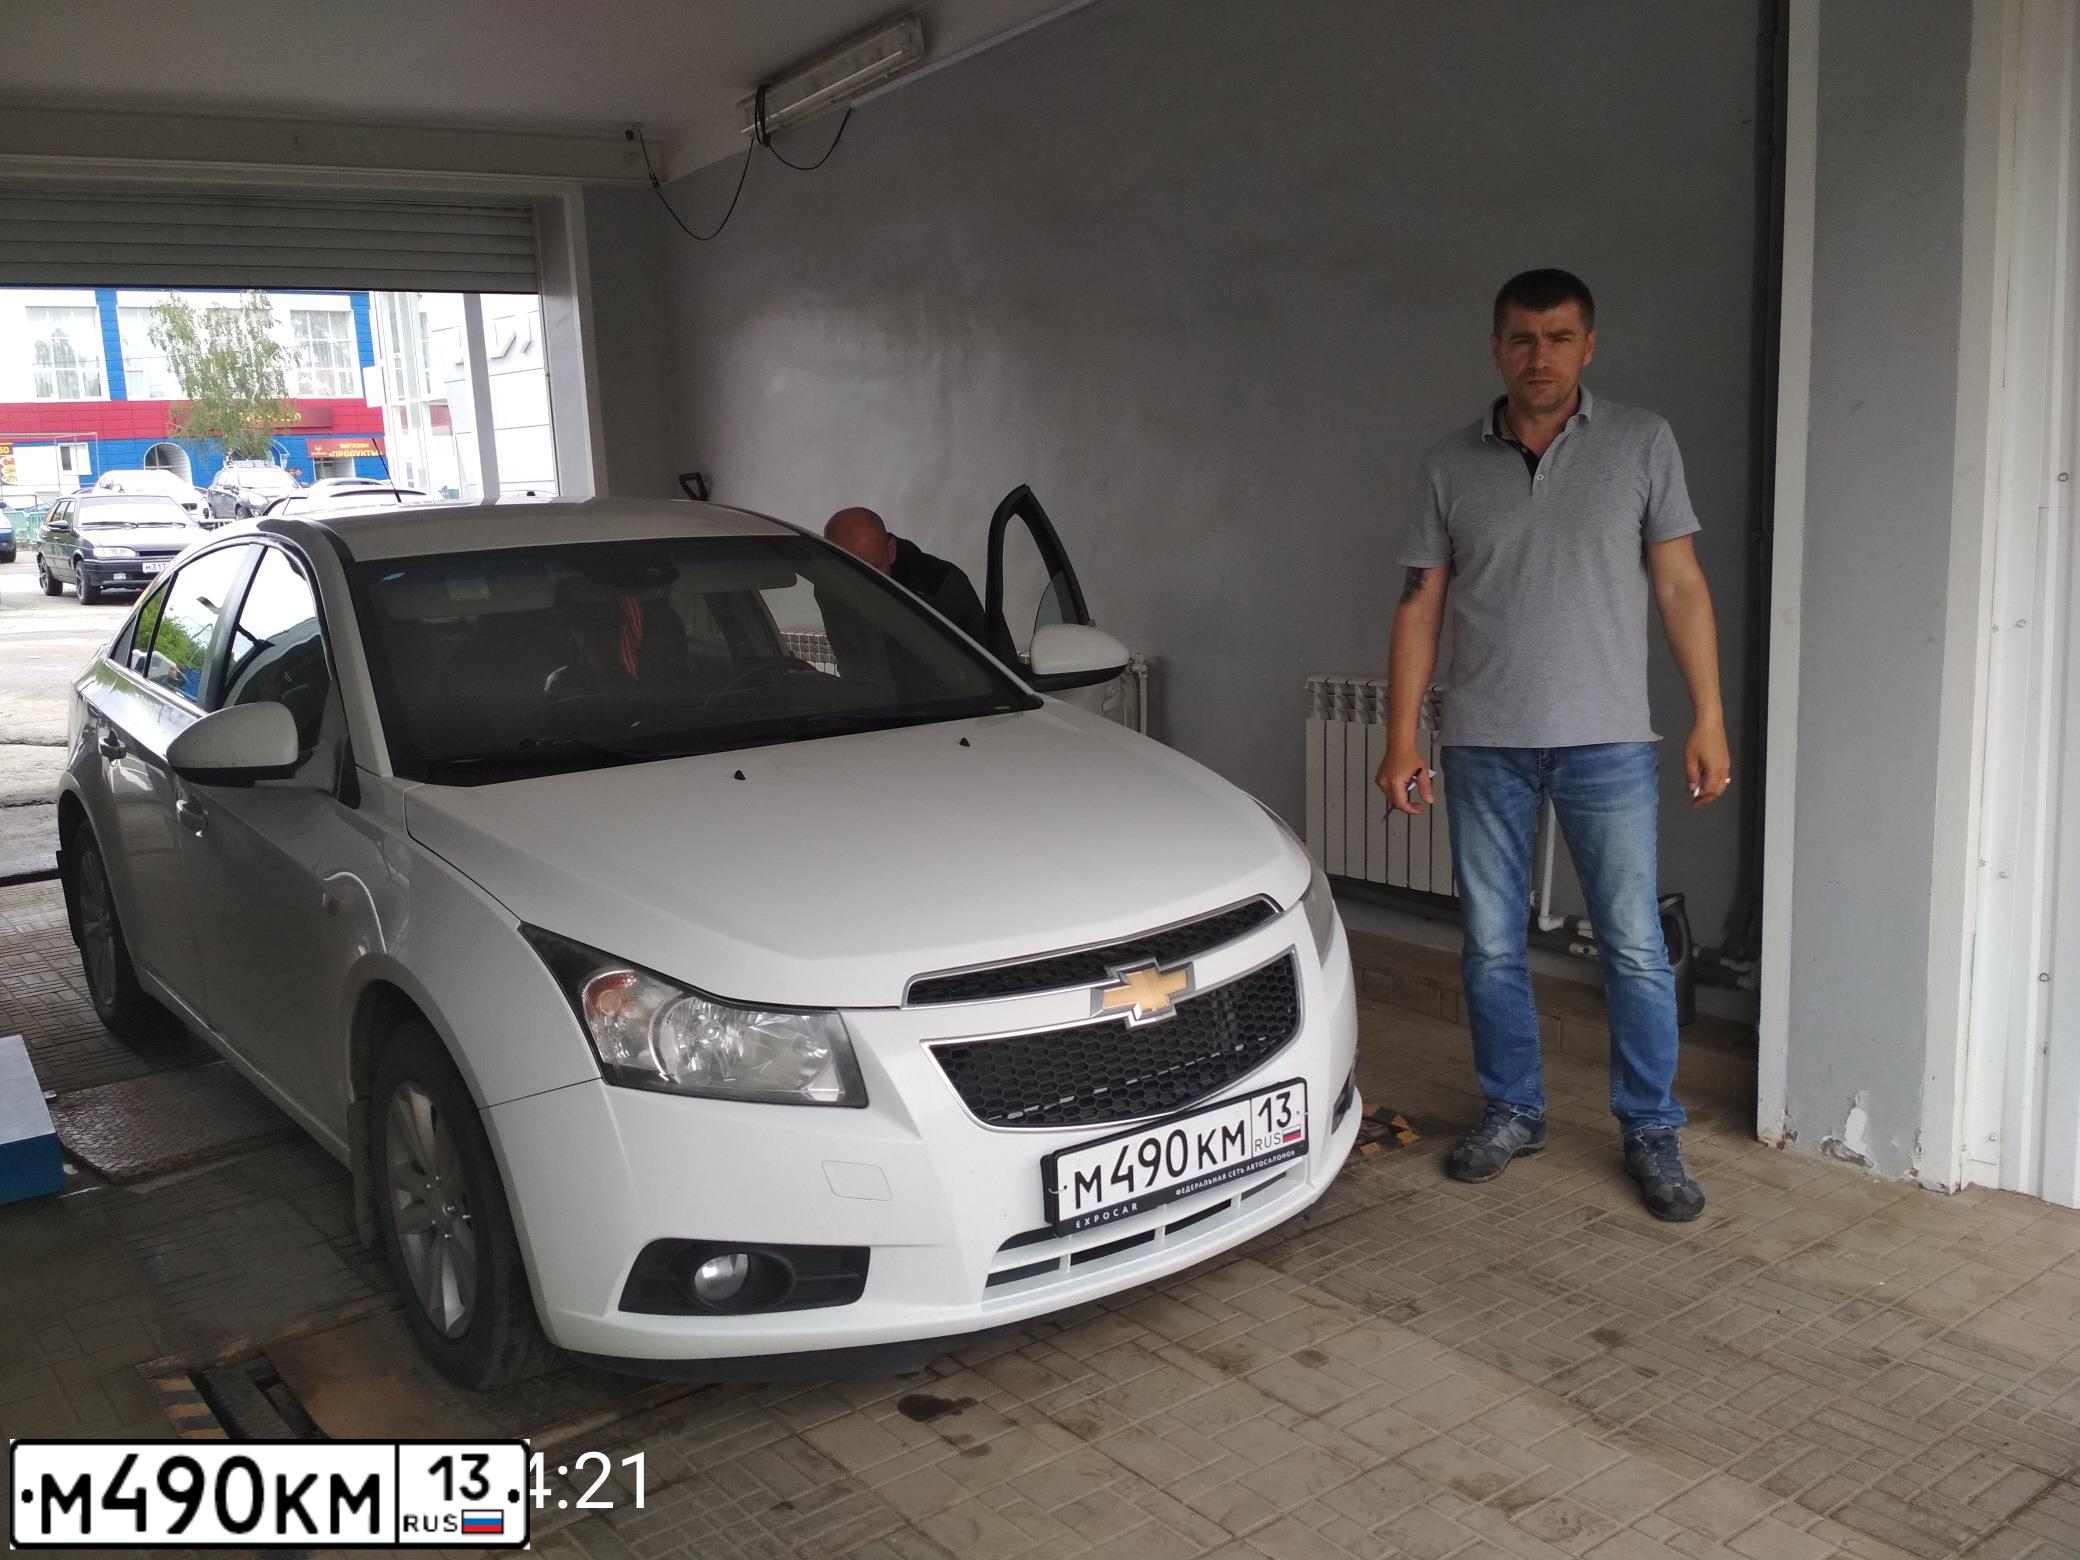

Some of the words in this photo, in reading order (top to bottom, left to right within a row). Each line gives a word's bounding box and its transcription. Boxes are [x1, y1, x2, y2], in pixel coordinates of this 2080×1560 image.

[145, 562, 167, 571] М317
[1258, 1090, 1292, 1133] 13
[1254, 1132, 1281, 1152] RUS
[1074, 1119, 1246, 1210] М490КМ
[1175, 1171, 1227, 1196] ФЕДЕРАЛЬНАЯ
[1227, 1166, 1246, 1179] СЕТЬ
[1245, 1149, 1296, 1172] АВТОСАЛОНОВ
[1075, 1202, 1138, 1229] EXPOCAR
